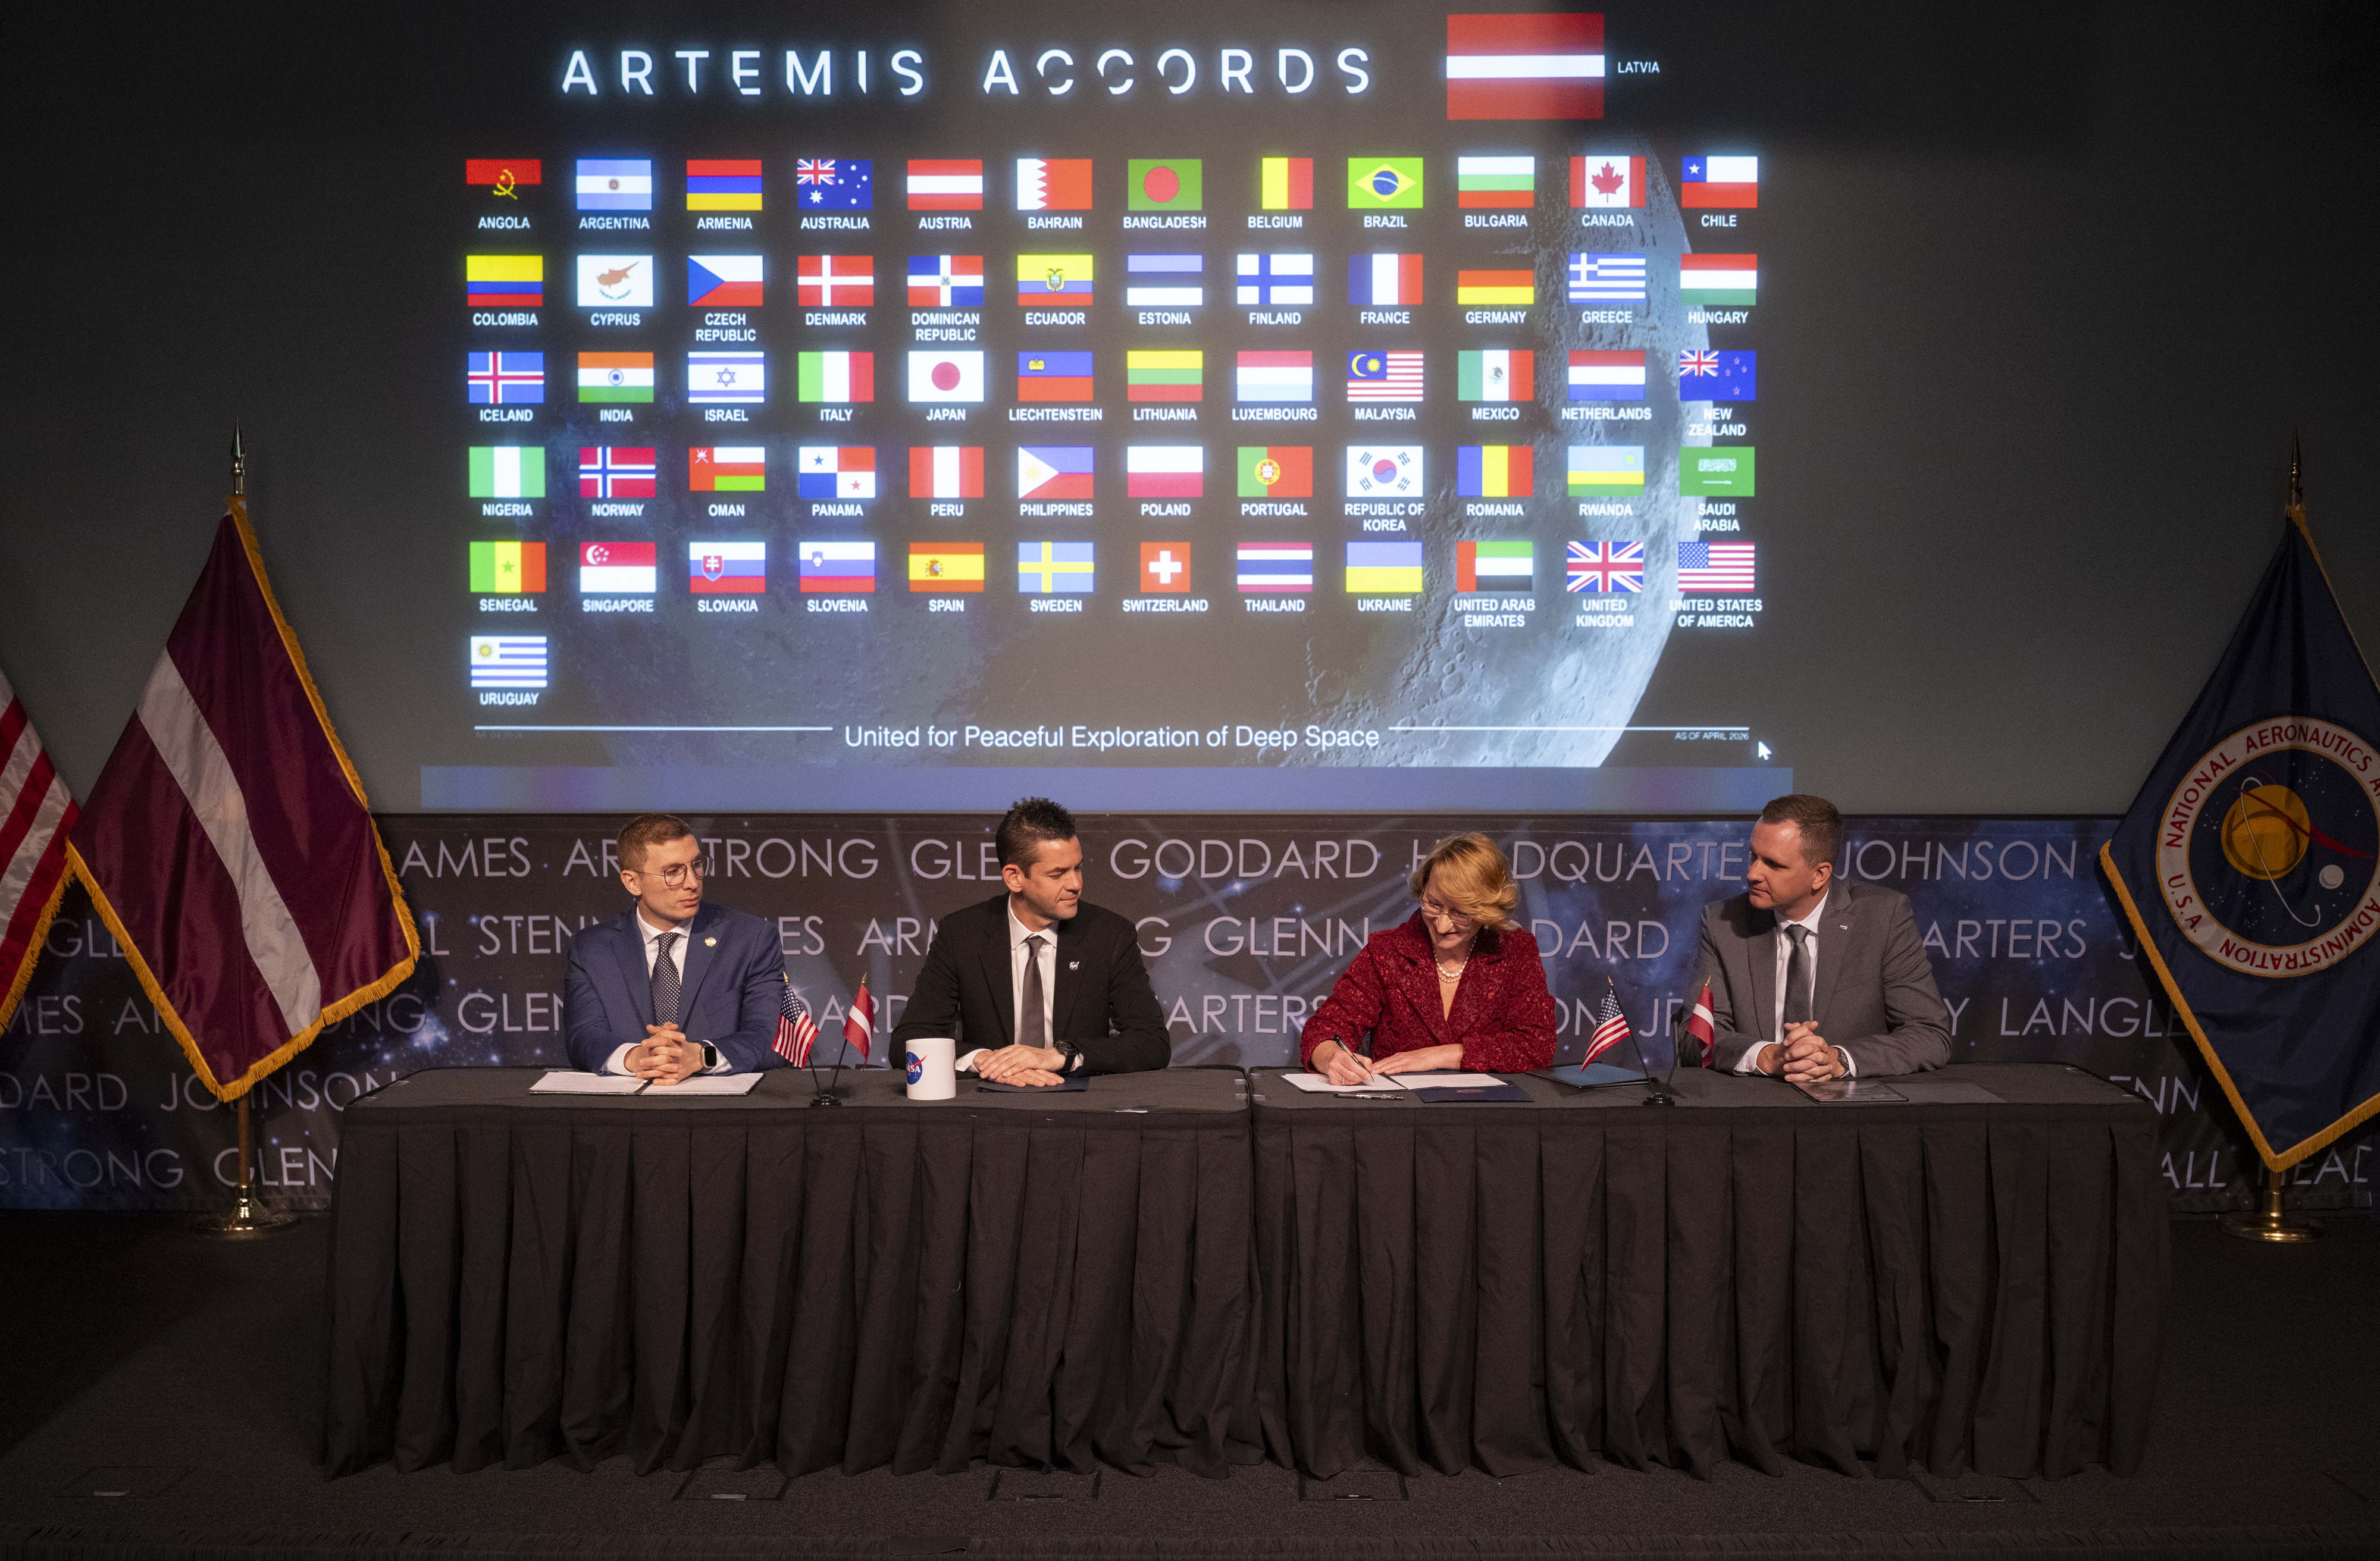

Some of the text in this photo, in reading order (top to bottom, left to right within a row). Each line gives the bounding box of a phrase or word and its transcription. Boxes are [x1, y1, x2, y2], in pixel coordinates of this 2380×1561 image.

[561, 47, 1369, 96] ARTEMIS ACCORDS
[1617, 61, 1661, 74] LATVIA
[477, 215, 531, 230] ANGOLA
[578, 216, 650, 230] ARGENTINA
[696, 217, 753, 230] ARMENIA
[800, 216, 870, 230] AUSTRALIA
[918, 216, 972, 230] AUSTRIA
[1028, 216, 1083, 230] BAHRAIN
[1123, 215, 1207, 229] BANGLADESH
[1247, 215, 1303, 228] BELGIUM
[1363, 215, 1408, 228] BRAZIL
[1464, 214, 1529, 228] BULGARIA
[1581, 214, 1635, 227] CANADA
[1701, 214, 1737, 227] CHILE
[472, 312, 539, 327] COLOMBIA
[590, 312, 641, 327] CYPRUS
[704, 312, 747, 327] CZECH
[805, 312, 867, 326] DENMARK
[911, 312, 980, 325] DOMINICAN
[1025, 312, 1086, 325] ECUADOR
[1138, 312, 1192, 325] ESTONIA
[1249, 312, 1302, 325] FINLAND
[1360, 311, 1411, 324] FRANCE
[1465, 311, 1527, 324] GERMANY
[1581, 311, 1633, 324] GREECE
[1688, 311, 1749, 324] HUNGARY
[695, 328, 757, 342] REPUBLIC
[915, 328, 976, 341] REPUBLIC
[479, 408, 534, 422] ICELAND
[599, 409, 634, 422] INDIA
[704, 408, 749, 422] ISRAEL
[820, 408, 853, 422] ITALY
[926, 408, 966, 421] JAPAN
[1009, 408, 1103, 421] LIECHTENSTEIN
[1133, 408, 1198, 421] LITHUANIA
[1232, 408, 1318, 421] LUXEMBOURG
[1354, 408, 1417, 421] MALAYSIA
[1471, 407, 1520, 421] MEXICO
[1561, 407, 1652, 421] NETHERLANDS
[1703, 408, 1733, 421] NEW
[1688, 423, 1747, 437] ZEALAND
[482, 503, 534, 517] NIGERIA
[591, 503, 645, 517] NORWAY
[707, 503, 746, 517] OMAN
[812, 503, 864, 516] PANAMA
[930, 503, 964, 517] PERU
[1019, 503, 1094, 516] PHILIPPINES
[1141, 503, 1191, 516] POLAND
[1241, 503, 1308, 516] PORTUGAL
[1344, 503, 1425, 516] REPUBLIC OF
[1466, 503, 1524, 517] ROMANIA
[1579, 503, 1633, 516] RWANDA
[1697, 503, 1736, 516] SAUDI
[1363, 518, 1407, 532] KOREA
[1692, 519, 1740, 532] ARABIA
[479, 598, 538, 612] SENEGAL
[582, 598, 654, 613] SINGAPORE
[697, 598, 759, 613] SLOVAKIA
[807, 598, 869, 613] SLOVENIA
[928, 598, 964, 612] SPAIN
[1030, 598, 1082, 613] SWEDEN
[1122, 598, 1209, 612] SWITZERLAND
[1244, 598, 1305, 612] THAILAND
[1357, 598, 1412, 612] UKRAINE
[1454, 598, 1536, 612] UNITED ARAB
[1582, 598, 1628, 612] UNITED
[1669, 598, 1763, 612] UNITED STATES
[1464, 614, 1526, 628] EMIRATES
[1576, 614, 1634, 628] KINGDOM
[1677, 614, 1754, 628] OF AMERICA
[479, 692, 540, 706] URUGUAY
[845, 725, 1380, 752] United for Peaceful Exploration of Deep Space
[1674, 732, 1687, 740] AS
[1688, 732, 1701, 740] OF
[1702, 732, 1727, 740] APRIL
[2165, 723, 2373, 848] NATIONAL AERONAUTICS
[399, 837, 531, 879] AMES
[562, 837, 879, 879] ARTRONG
[911, 838, 1003, 881] GLE
[1110, 838, 1379, 880] GODDARD
[1833, 839, 2077, 882] JOHNSON
[777, 914, 825, 955] ES
[1204, 916, 1370, 958] GLENN
[1532, 919, 1670, 960] DARD
[1921, 919, 2087, 960] ARTERS
[2219, 897, 2380, 971] ADMINISTRATION
[2000, 996, 2191, 1038] LANGLE
[906, 1064, 921, 1073] ASA
[213, 1147, 338, 1187] GLEN
